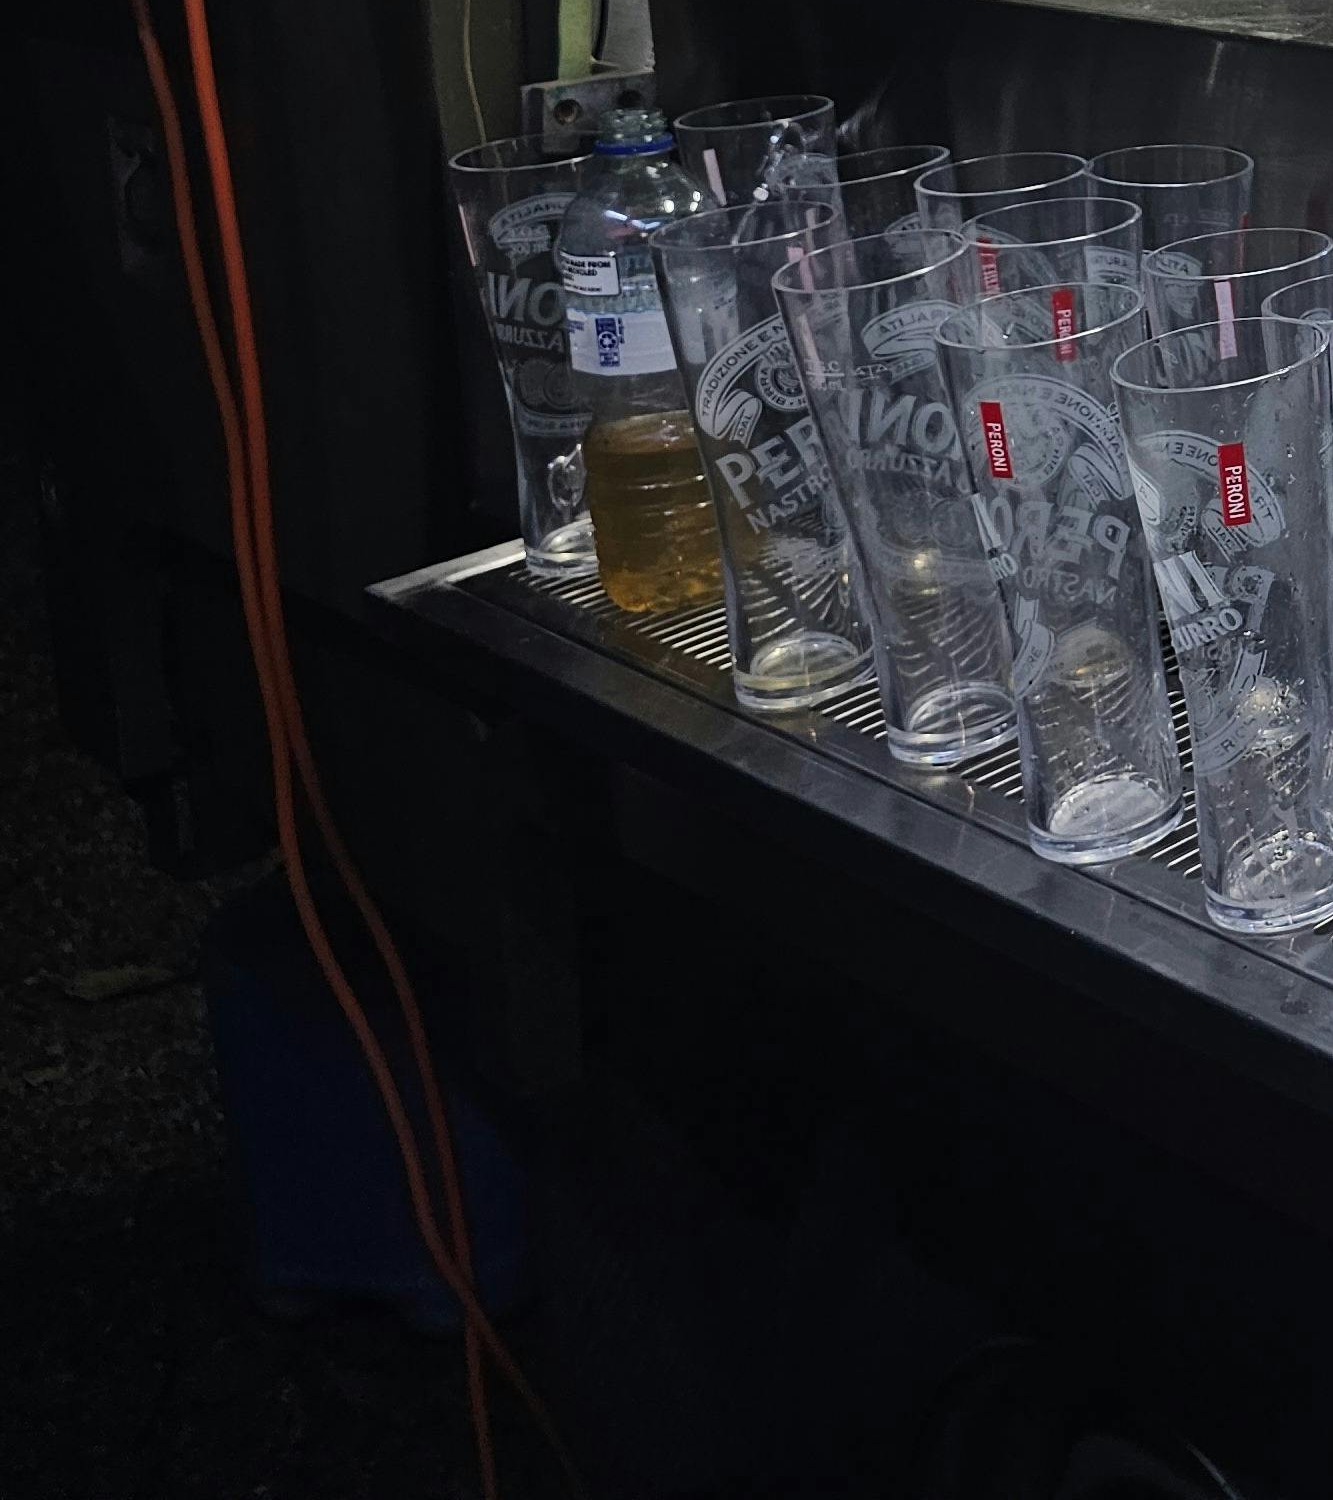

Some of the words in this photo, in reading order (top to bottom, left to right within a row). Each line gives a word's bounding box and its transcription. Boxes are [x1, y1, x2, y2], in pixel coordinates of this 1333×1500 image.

[702, 338, 760, 417] TRADIZIONE
[986, 422, 1009, 472] PERONI
[1225, 465, 1246, 520] PERONI
